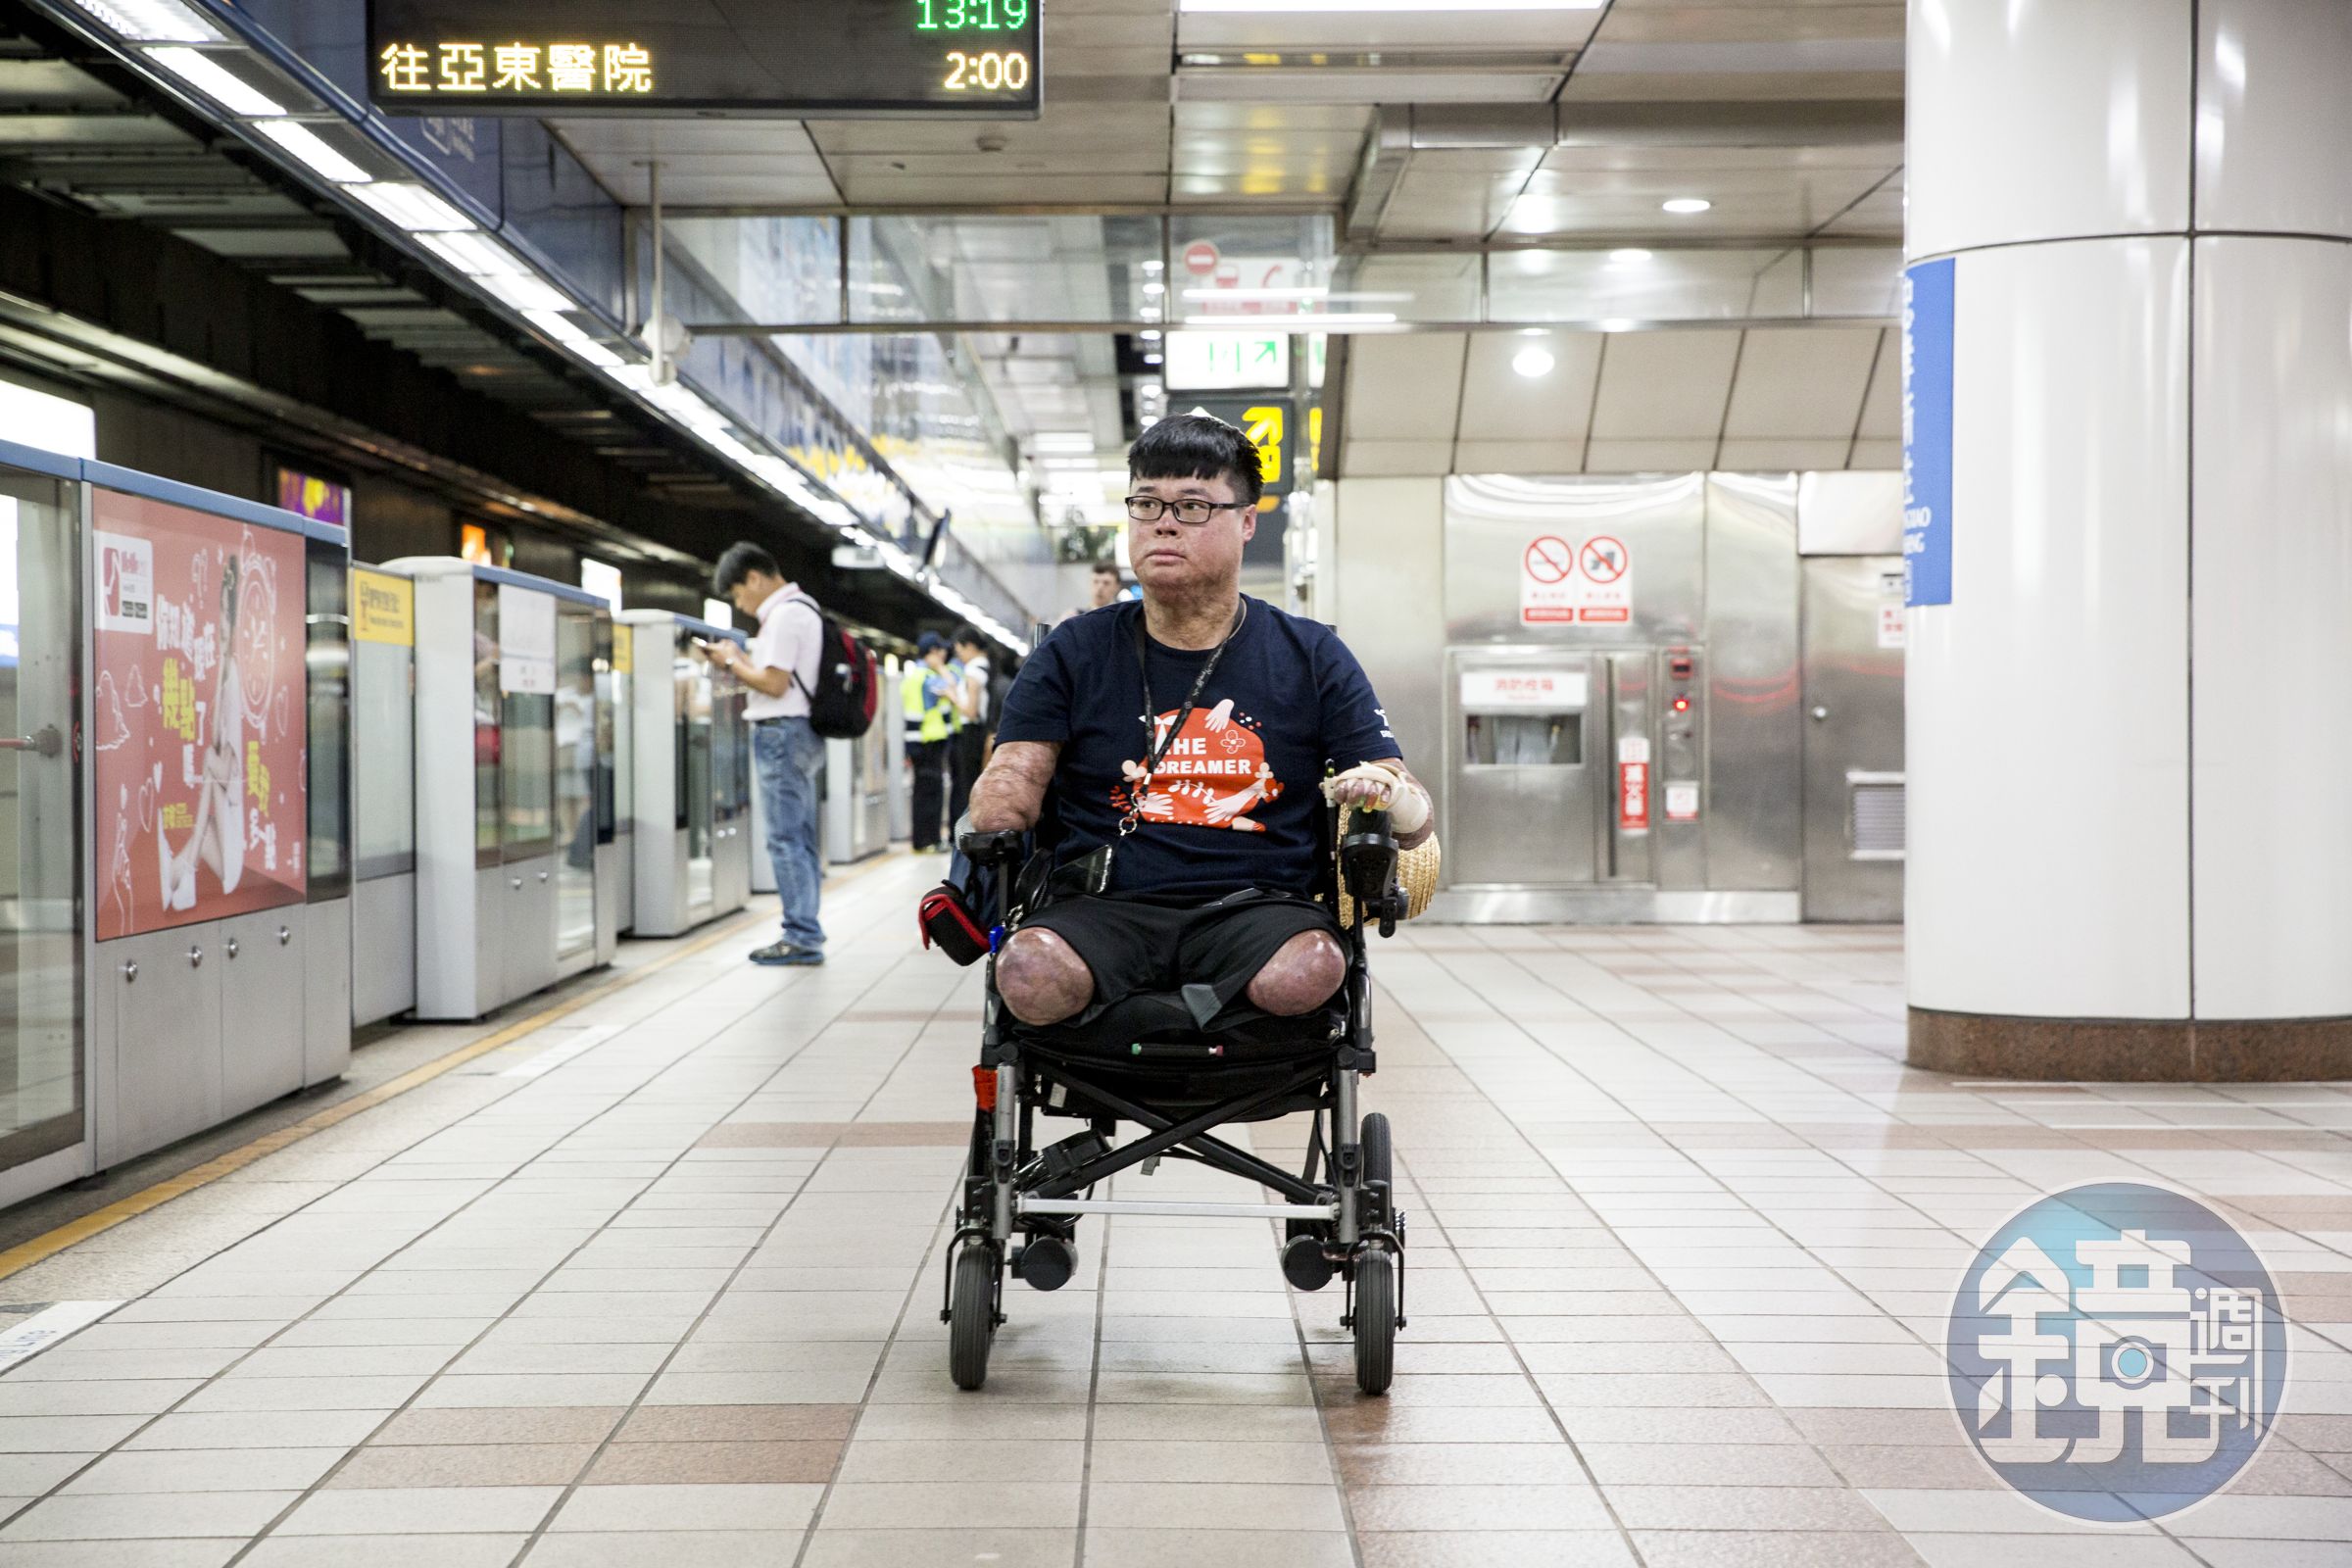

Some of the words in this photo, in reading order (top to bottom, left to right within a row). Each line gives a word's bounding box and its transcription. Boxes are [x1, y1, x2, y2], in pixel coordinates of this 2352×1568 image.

[917, 0, 1028, 29] 13:19
[381, 42, 652, 91] 往亞東醫院
[944, 52, 1028, 89] 2:00
[1153, 759, 1251, 774] DREAMER
